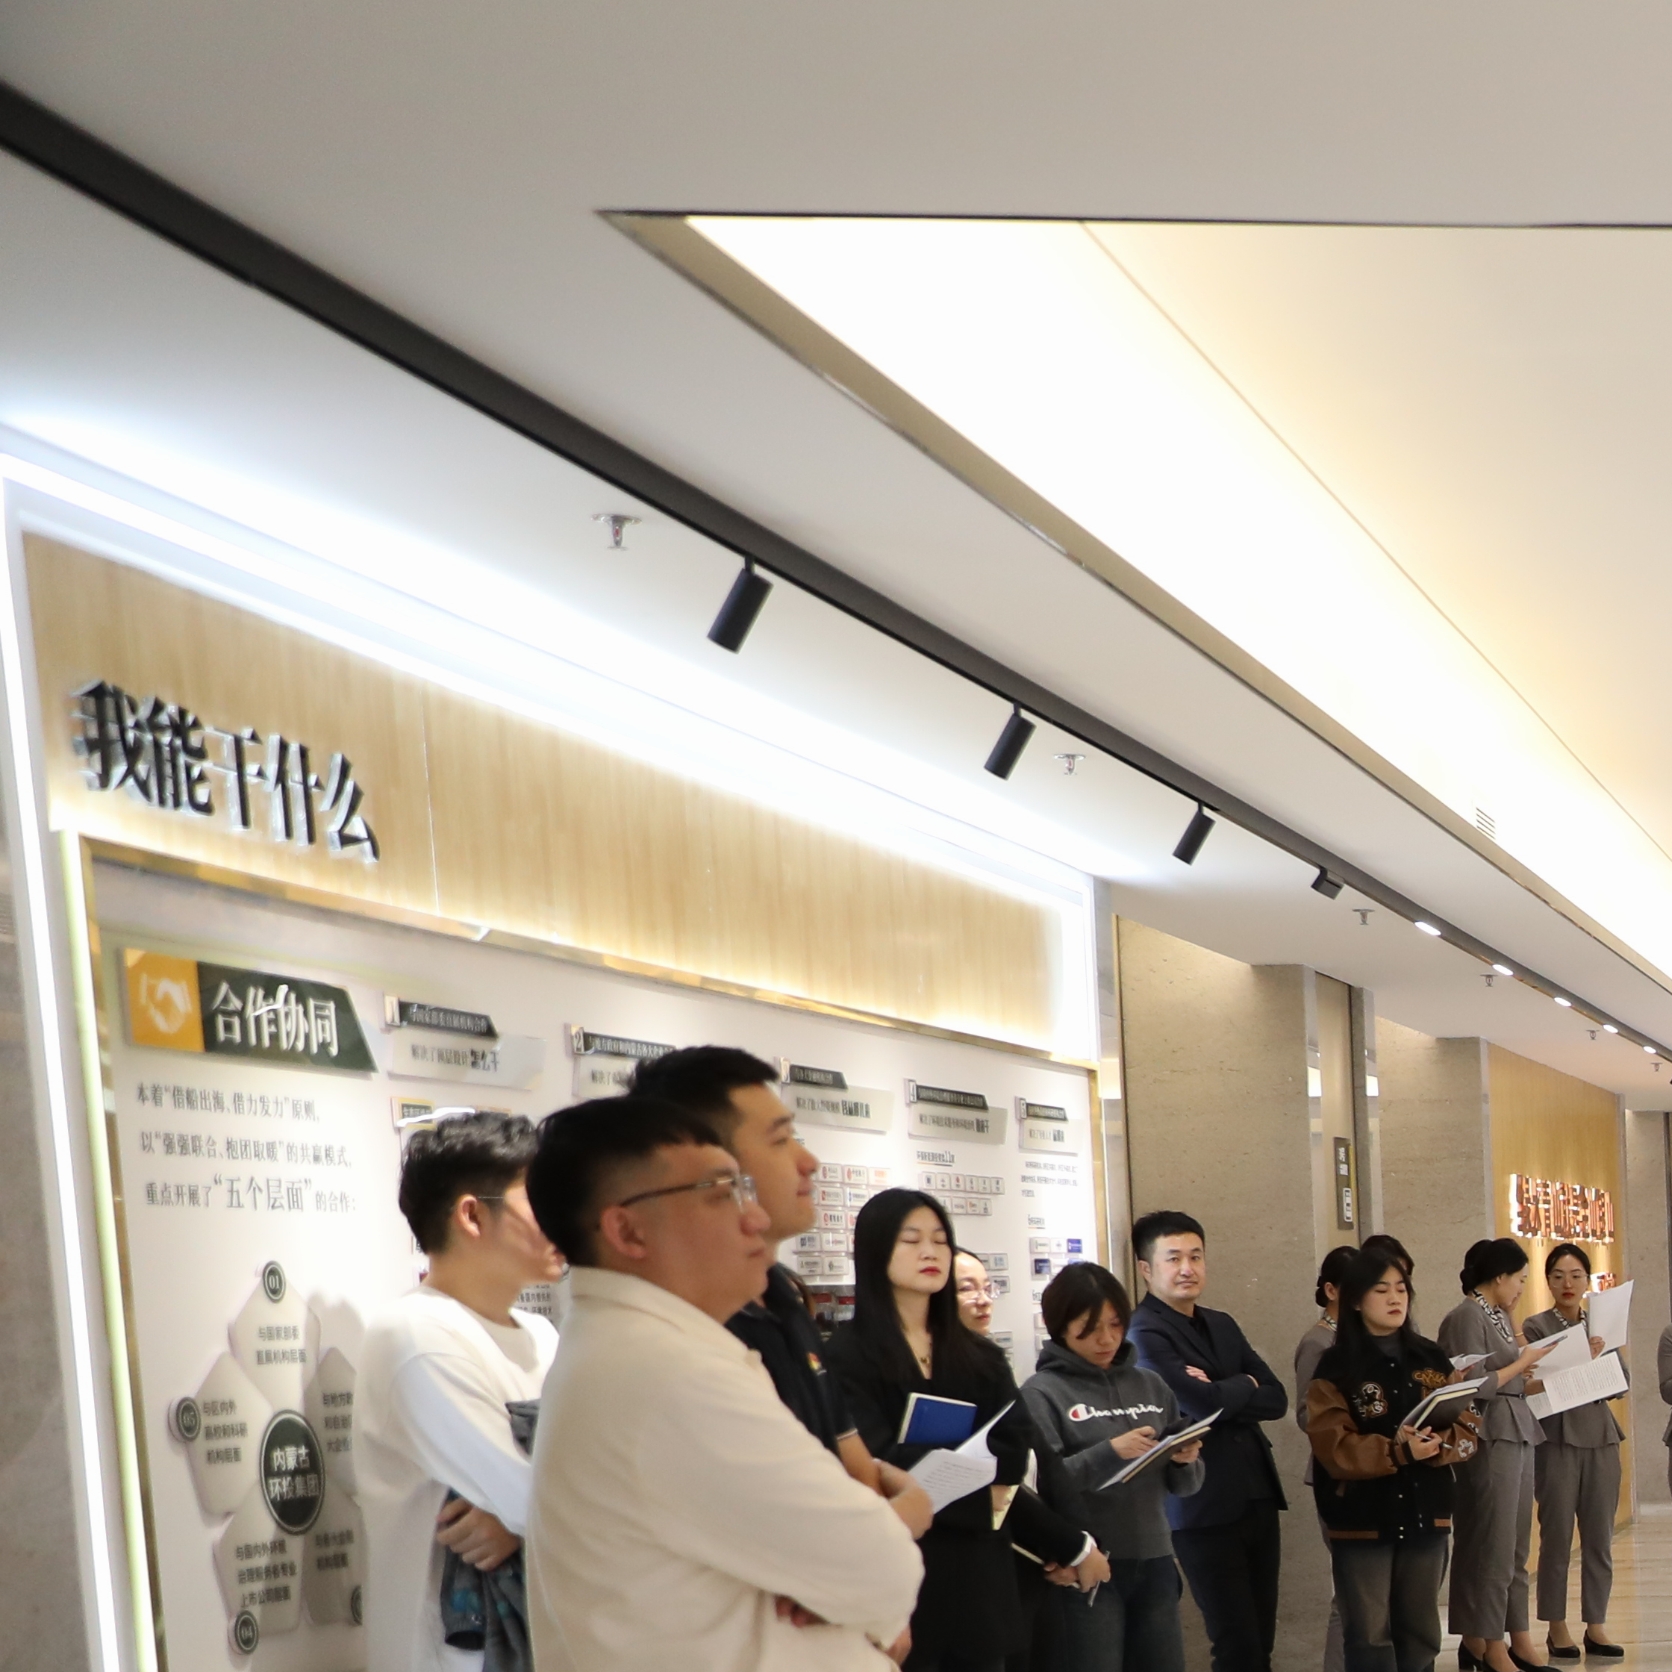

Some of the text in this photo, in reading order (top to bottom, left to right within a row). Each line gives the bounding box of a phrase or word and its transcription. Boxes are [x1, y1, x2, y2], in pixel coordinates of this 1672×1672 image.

[71, 680, 380, 863] 我能干什么
[212, 980, 339, 1057] 合作协同
[272, 1446, 311, 1472] 内蒙古
[268, 1474, 320, 1501] 环投集团
